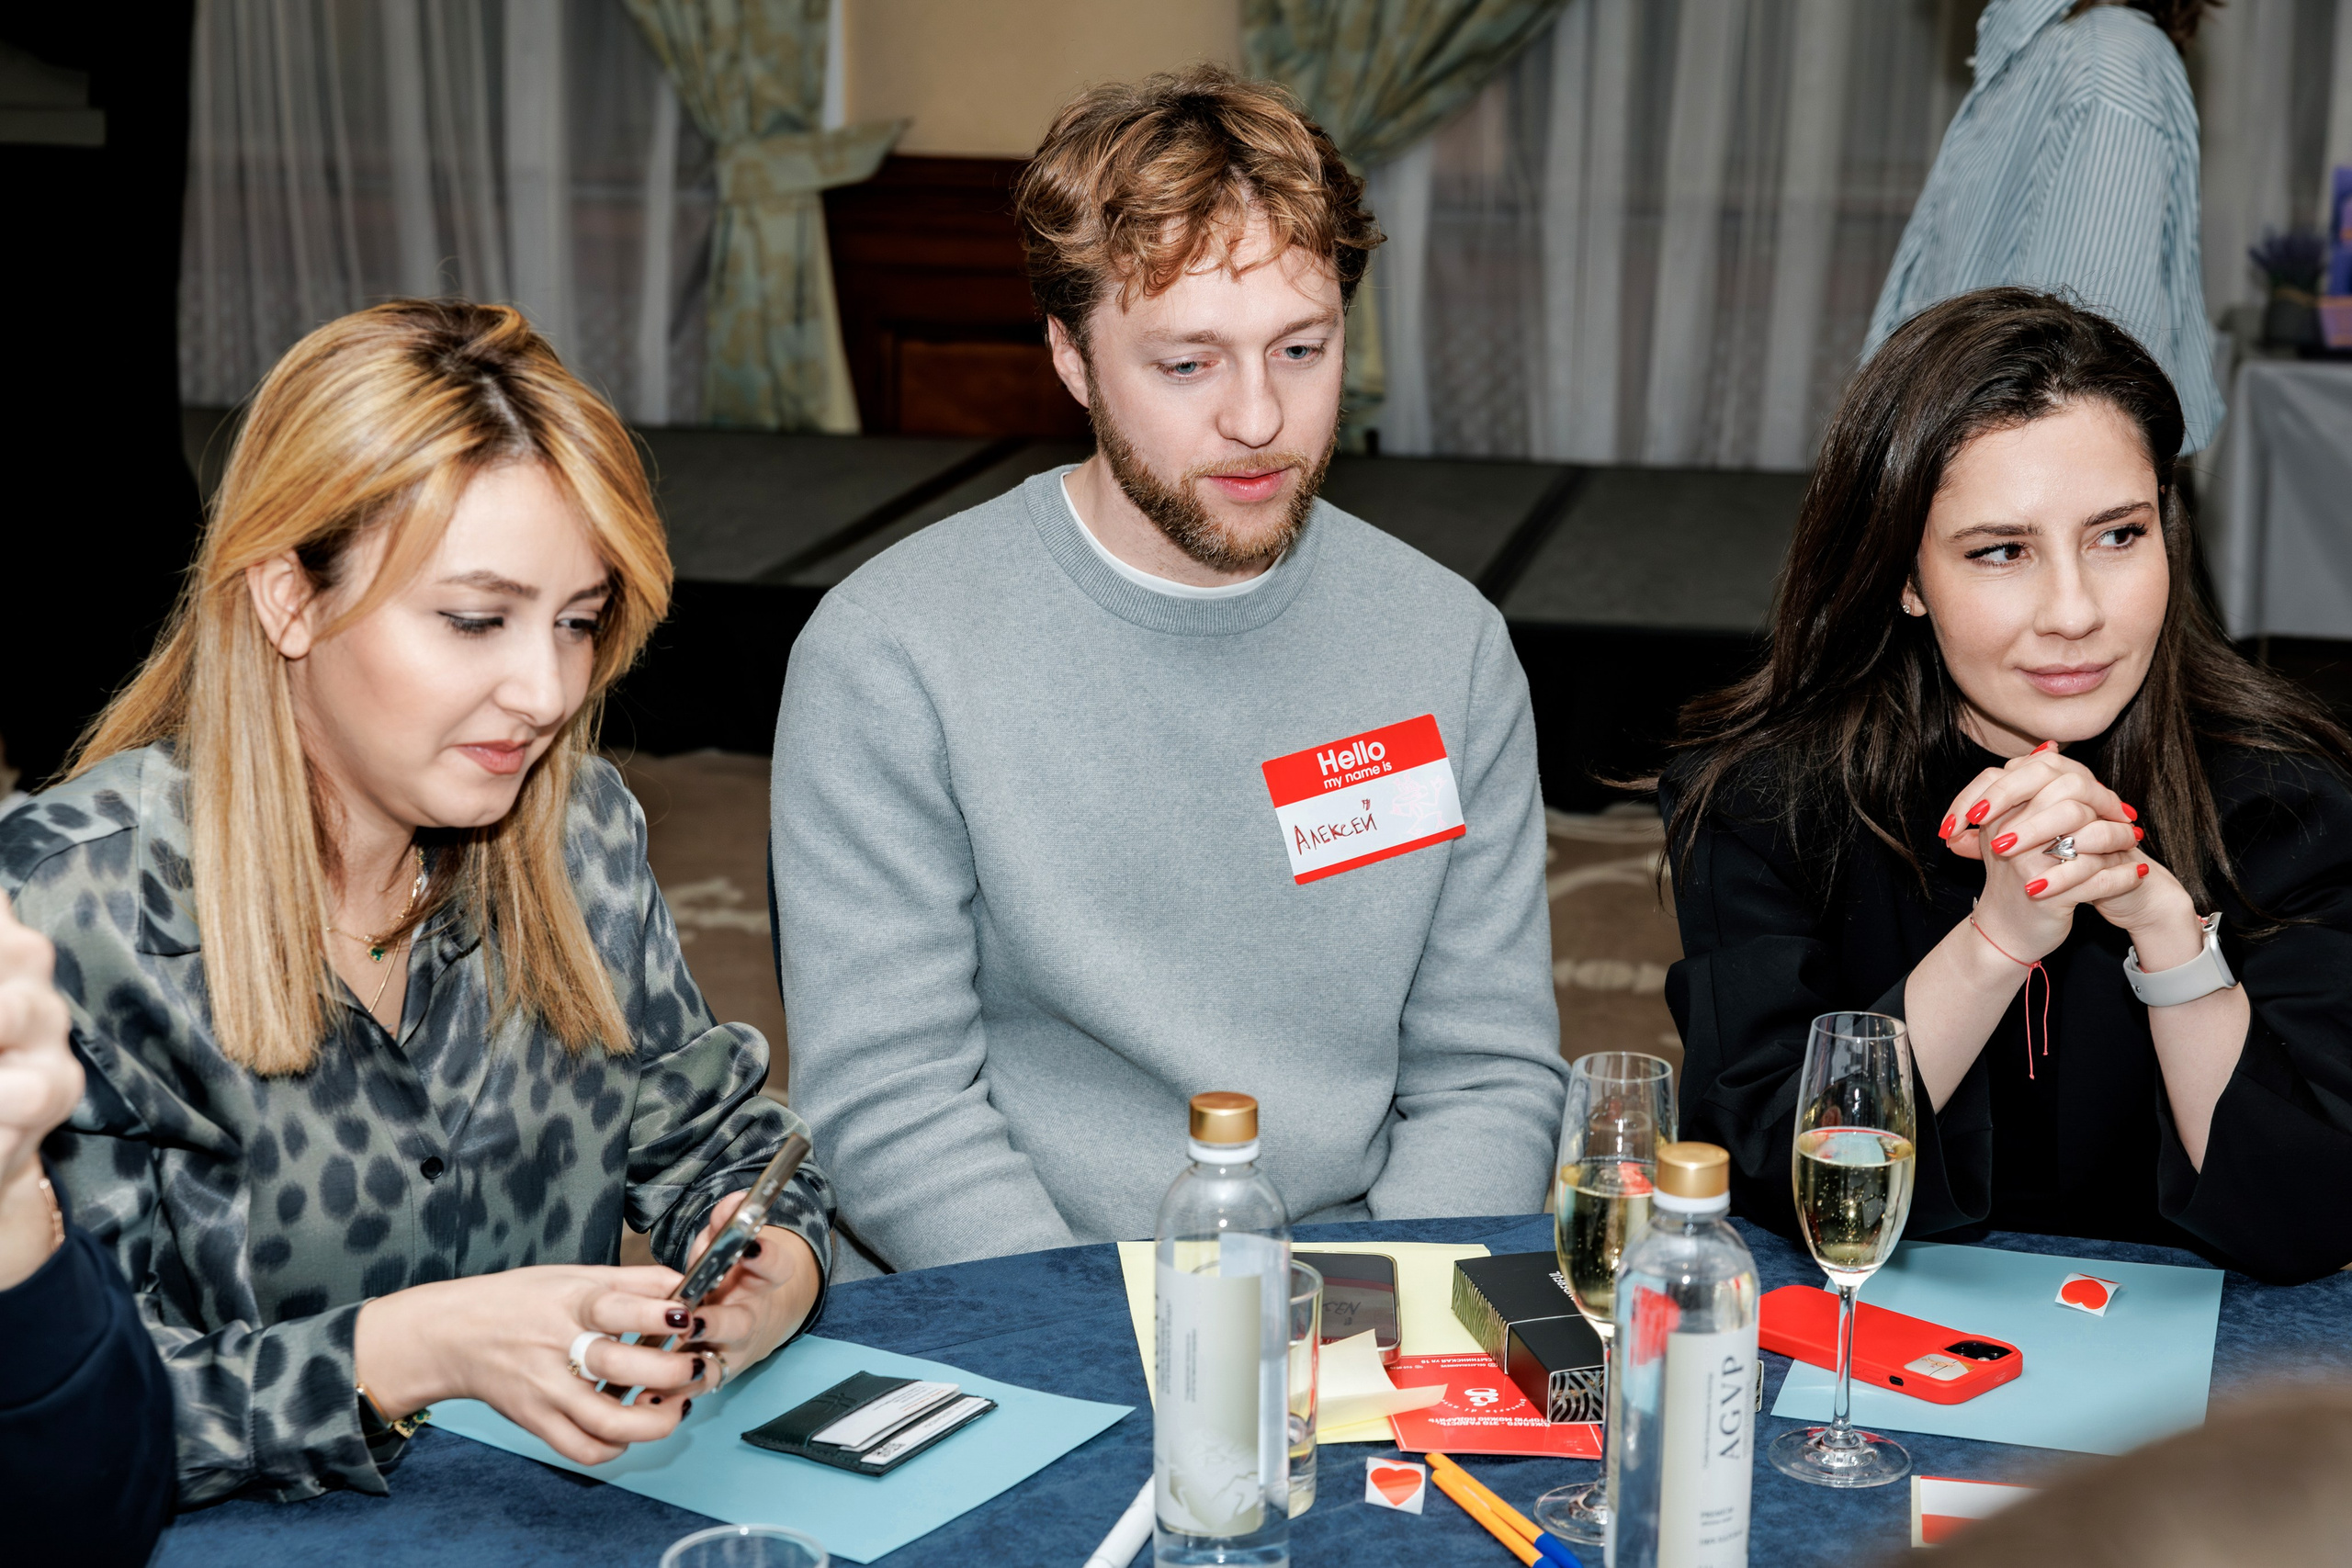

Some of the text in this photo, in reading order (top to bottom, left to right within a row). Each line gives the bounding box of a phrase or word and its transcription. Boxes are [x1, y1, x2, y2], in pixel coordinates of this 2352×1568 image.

[1317, 740, 1385, 776] Hello
[1323, 761, 1392, 790] my name is
[1716, 1354, 1745, 1461] AGVP
